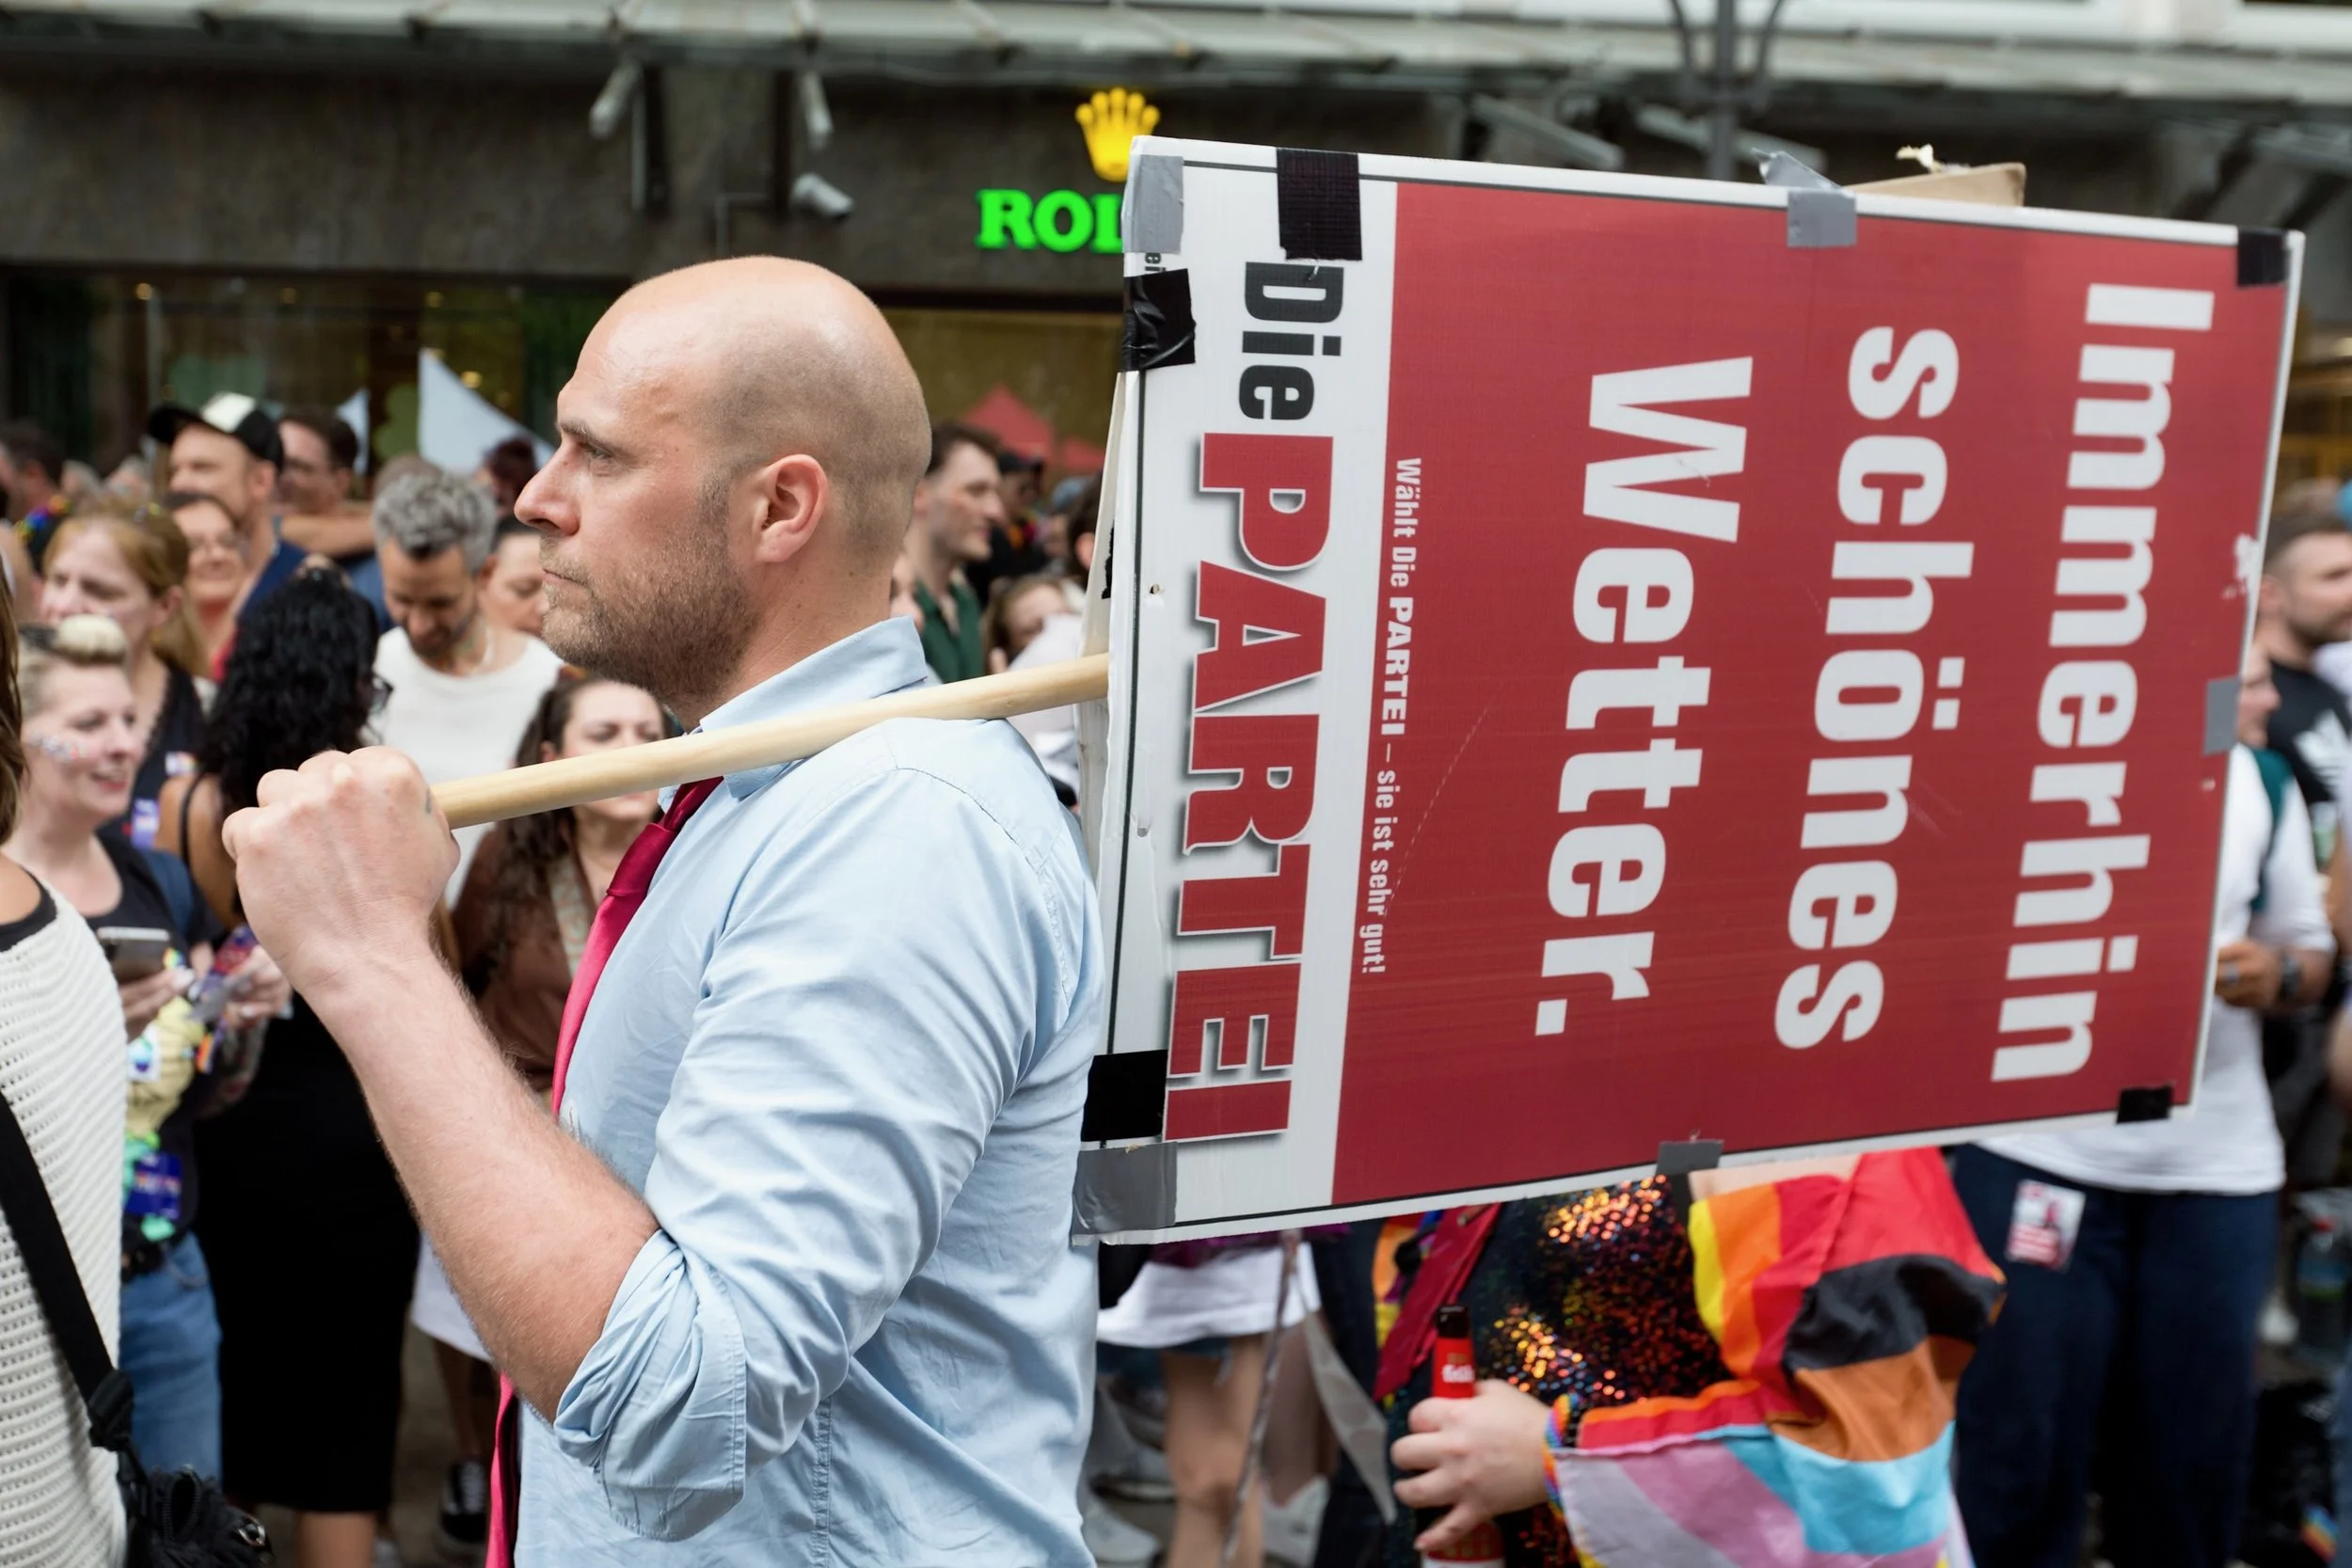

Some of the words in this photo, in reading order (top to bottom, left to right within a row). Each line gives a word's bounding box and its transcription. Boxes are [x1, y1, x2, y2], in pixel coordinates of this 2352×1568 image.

[975, 188, 1123, 253] ROL
[1238, 261, 1344, 420] Die
[1392, 457, 1422, 538] Wählt
[1390, 546, 1417, 588] Die
[1380, 596, 1414, 736] PARTEI
[1535, 356, 1754, 1037] Wetter.
[1773, 326, 1975, 1050] schönes
[1991, 283, 2215, 1083] Immerhin
[1163, 433, 1334, 1144] PARTEI
[1375, 769, 1401, 809] sie
[1372, 816, 1399, 851] ist
[1366, 858, 1392, 916] sehr
[1359, 923, 1386, 974] gut!
